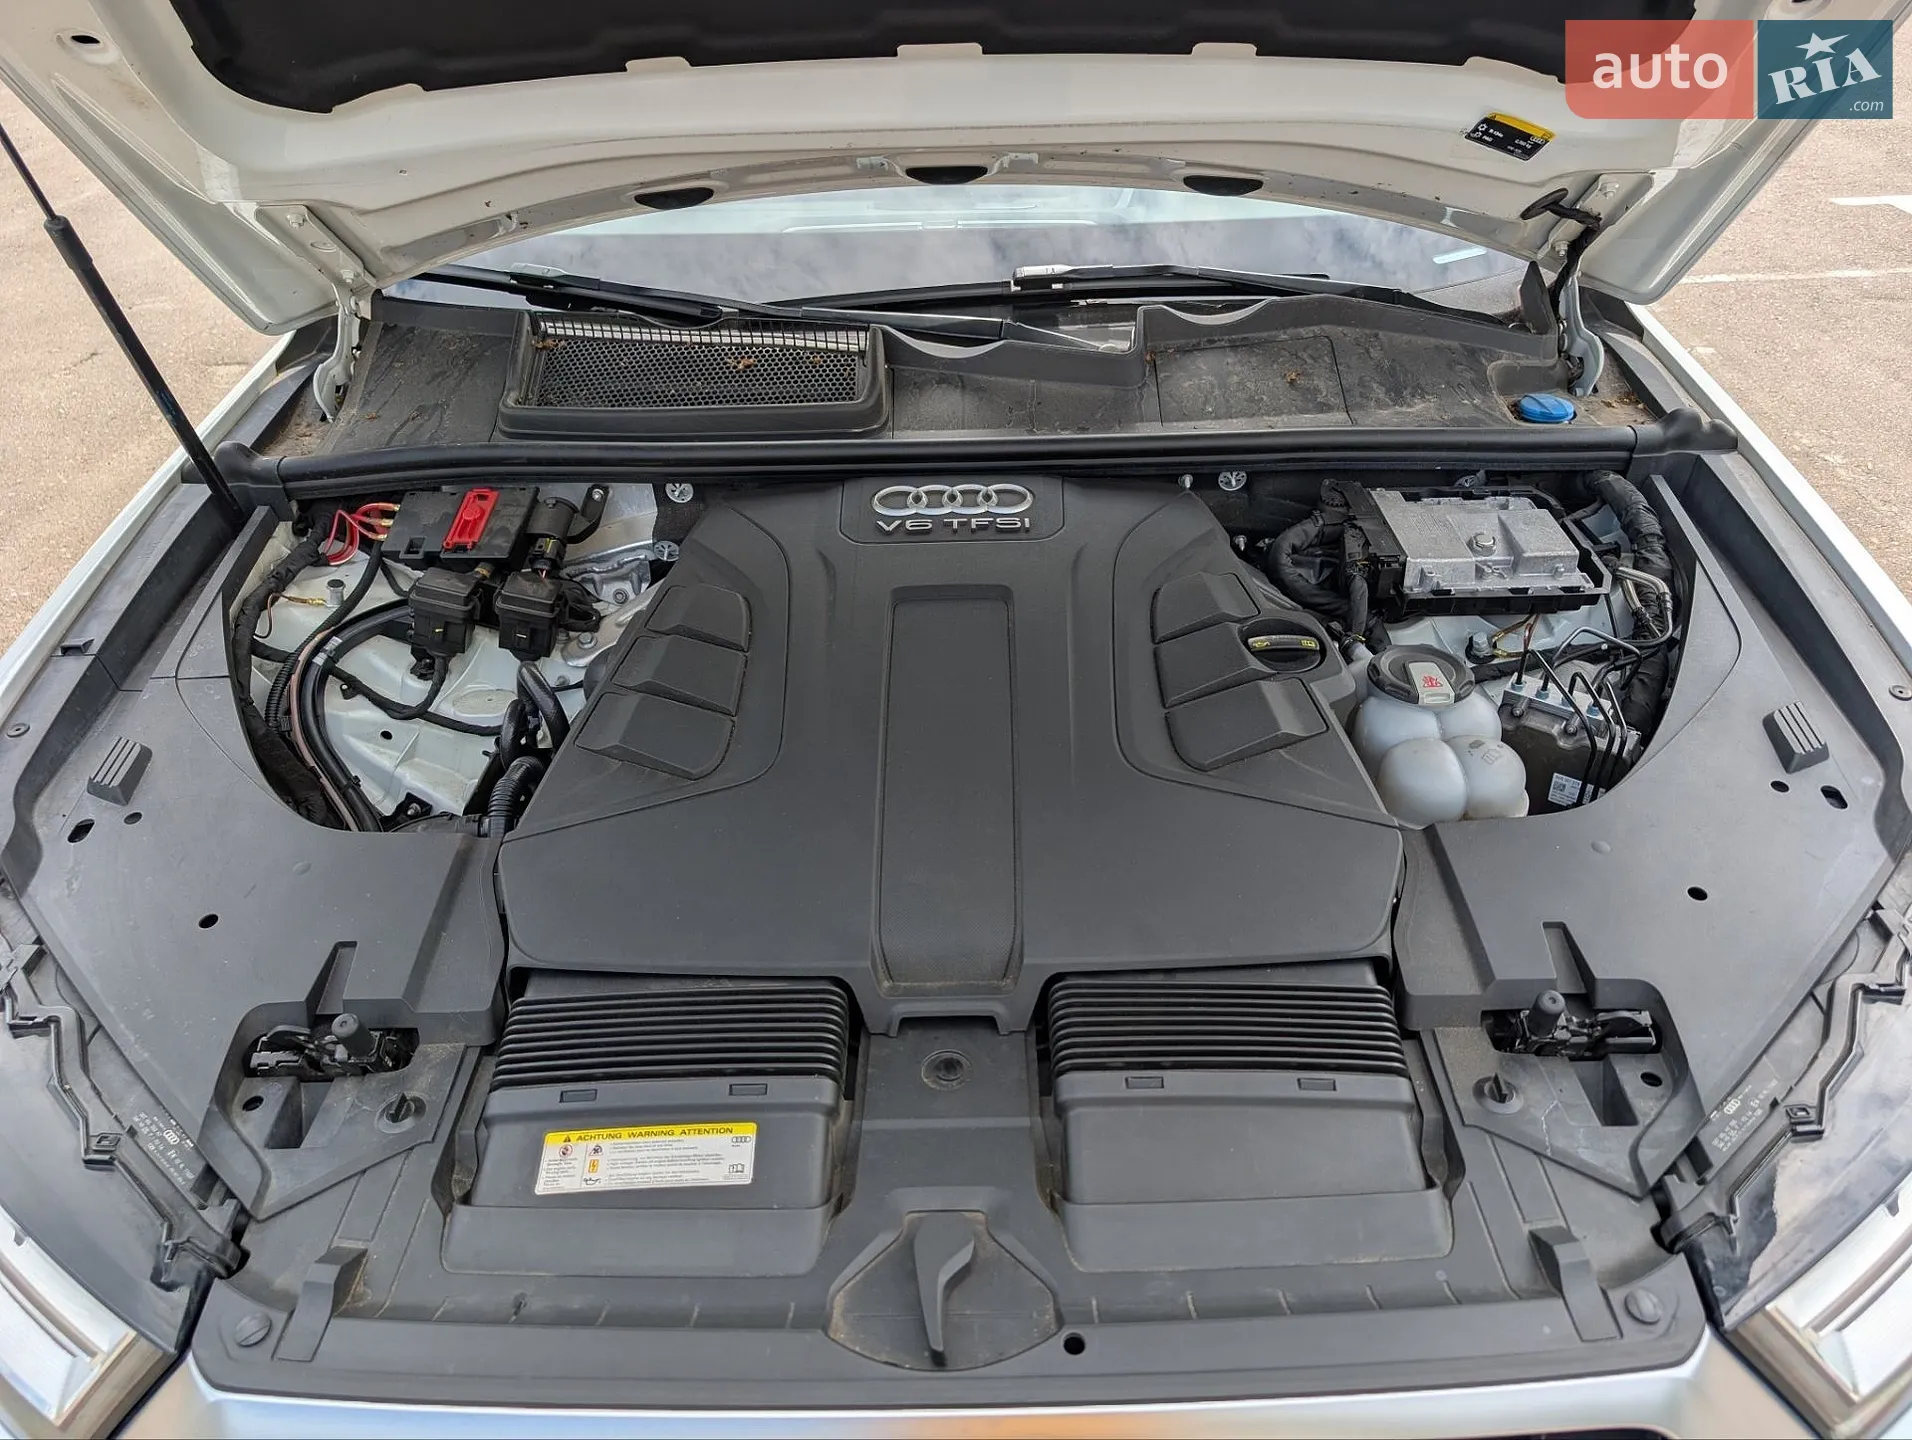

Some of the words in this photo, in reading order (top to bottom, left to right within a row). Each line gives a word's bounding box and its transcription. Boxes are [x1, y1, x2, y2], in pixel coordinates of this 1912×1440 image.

[876, 518, 933, 536] V6
[943, 517, 1031, 535] TFSI
[576, 1132, 622, 1142] ACHTUNG
[627, 1129, 675, 1138] WARNING
[679, 1126, 734, 1136] ATTENTION
